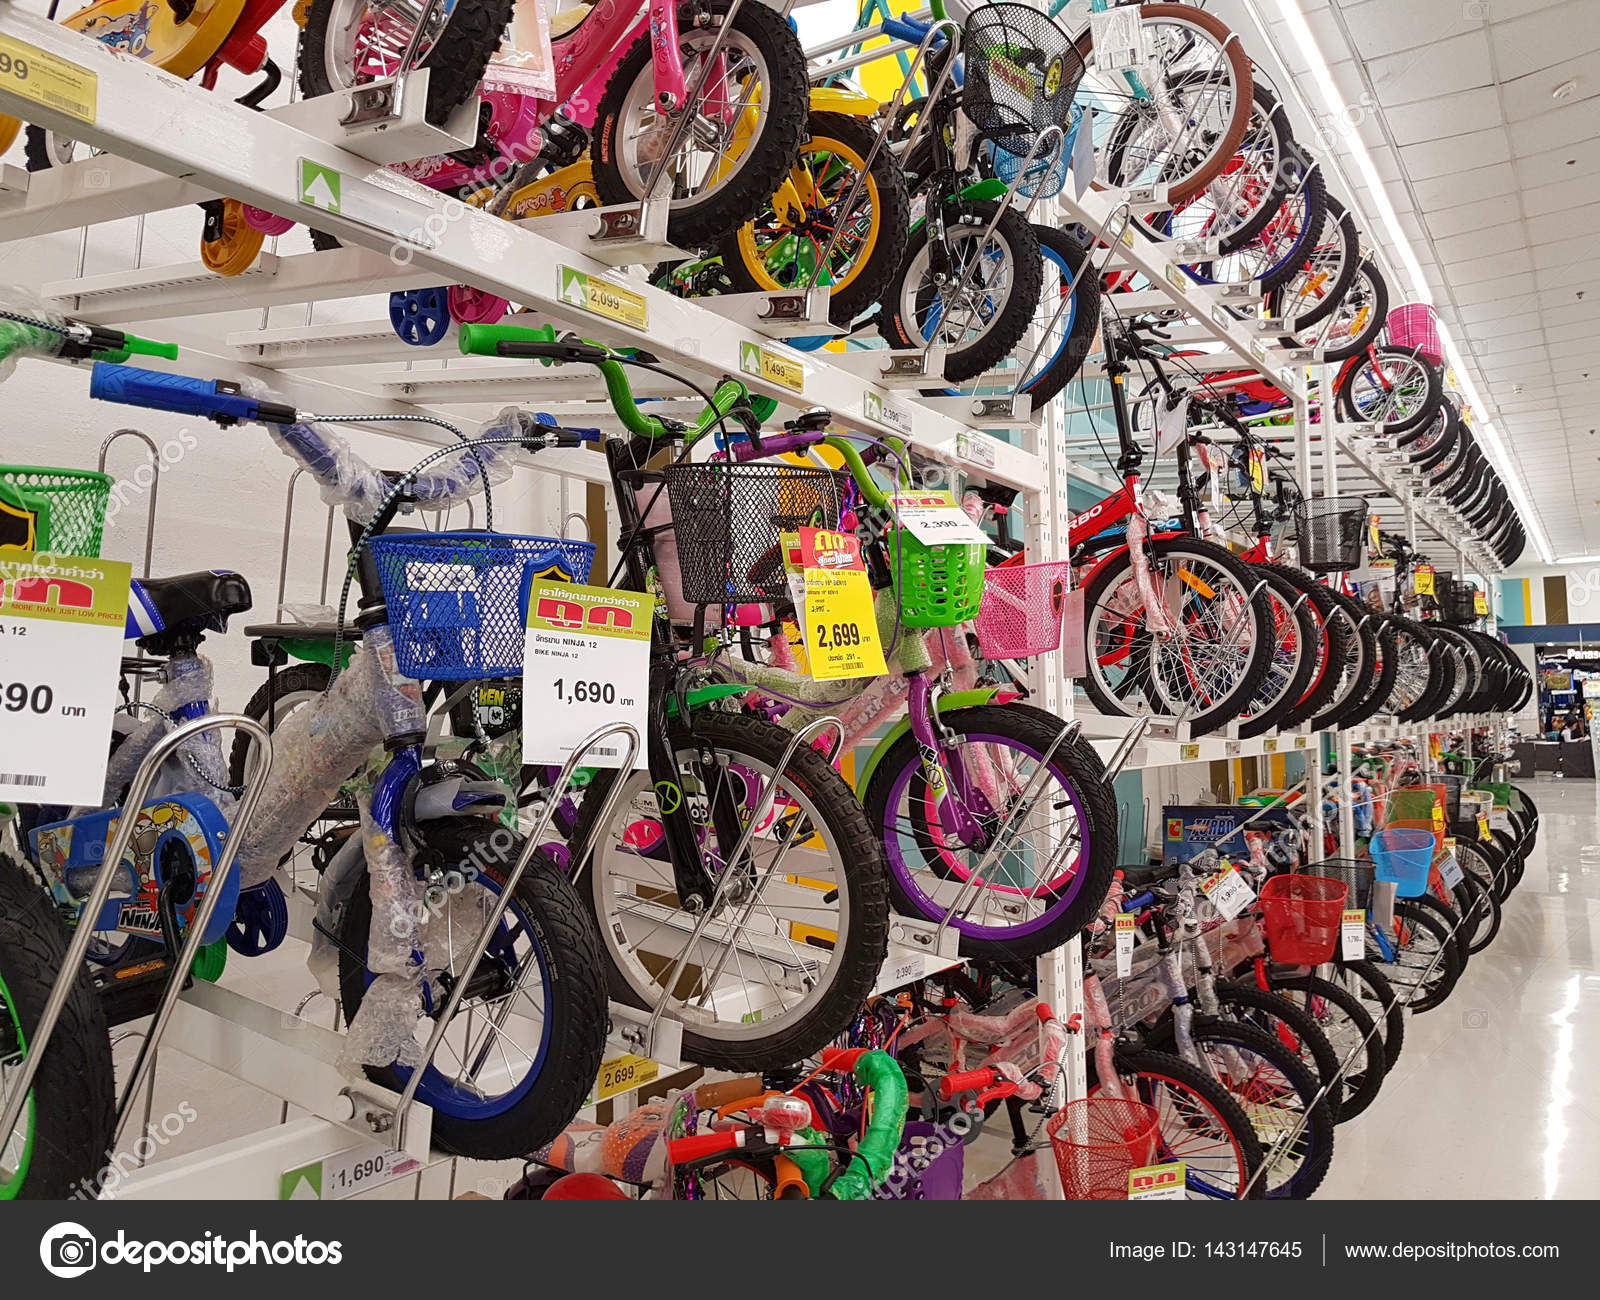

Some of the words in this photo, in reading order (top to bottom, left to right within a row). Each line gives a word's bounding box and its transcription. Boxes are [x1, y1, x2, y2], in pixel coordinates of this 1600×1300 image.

[590, 288, 620, 310] 2,099
[764, 360, 785, 377] 1,499
[920, 520, 958, 529] 2,390
[11, 603, 33, 611] MORE
[97, 612, 124, 621] PRICES
[536, 597, 633, 629] ถูก
[12, 626, 27, 636] 12
[817, 622, 860, 651] 2,699
[562, 636, 586, 648] NINJA
[588, 641, 597, 649] 12
[534, 648, 550, 656] BIKE
[551, 650, 570, 658] NINJA
[1567, 649, 1600, 660] Panas
[0, 682, 53, 714] 90
[61, 705, 86, 717] บาท
[553, 678, 616, 704] 1,690
[605, 1065, 634, 1088] 2,699
[338, 1155, 384, 1188] 1,690
